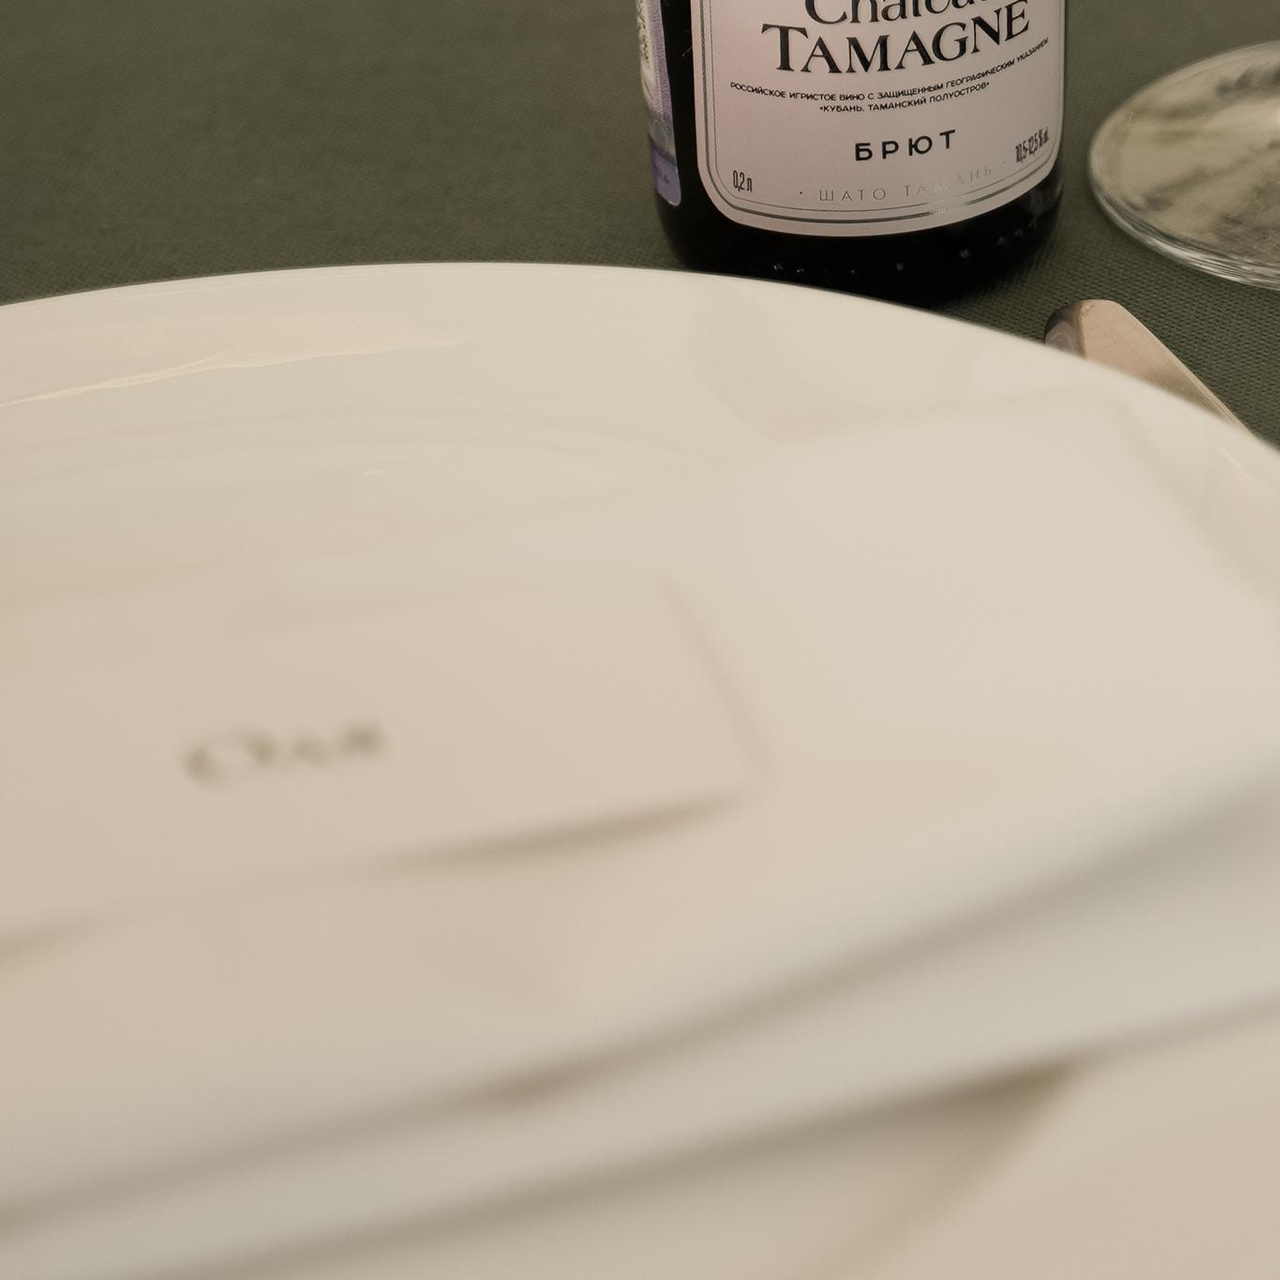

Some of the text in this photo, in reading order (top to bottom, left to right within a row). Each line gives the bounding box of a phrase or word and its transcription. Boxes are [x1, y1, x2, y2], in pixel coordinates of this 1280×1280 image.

[730, 81, 786, 98] РОССИЙСКОЕ
[789, 92, 837, 102] ИГРИСТОЕ
[839, 93, 865, 102] ВИНО
[868, 92, 875, 101] С
[877, 82, 944, 100] ЗАЩИЩЕННЫМ
[945, 58, 1015, 89] ГЕОГРАФИЧЕСКИМ
[868, 96, 927, 112] ТАМАНСКИЙ
[855, 129, 956, 161] БРЮТ
[733, 170, 745, 192] 0,2
[818, 189, 887, 202] ШАТО
